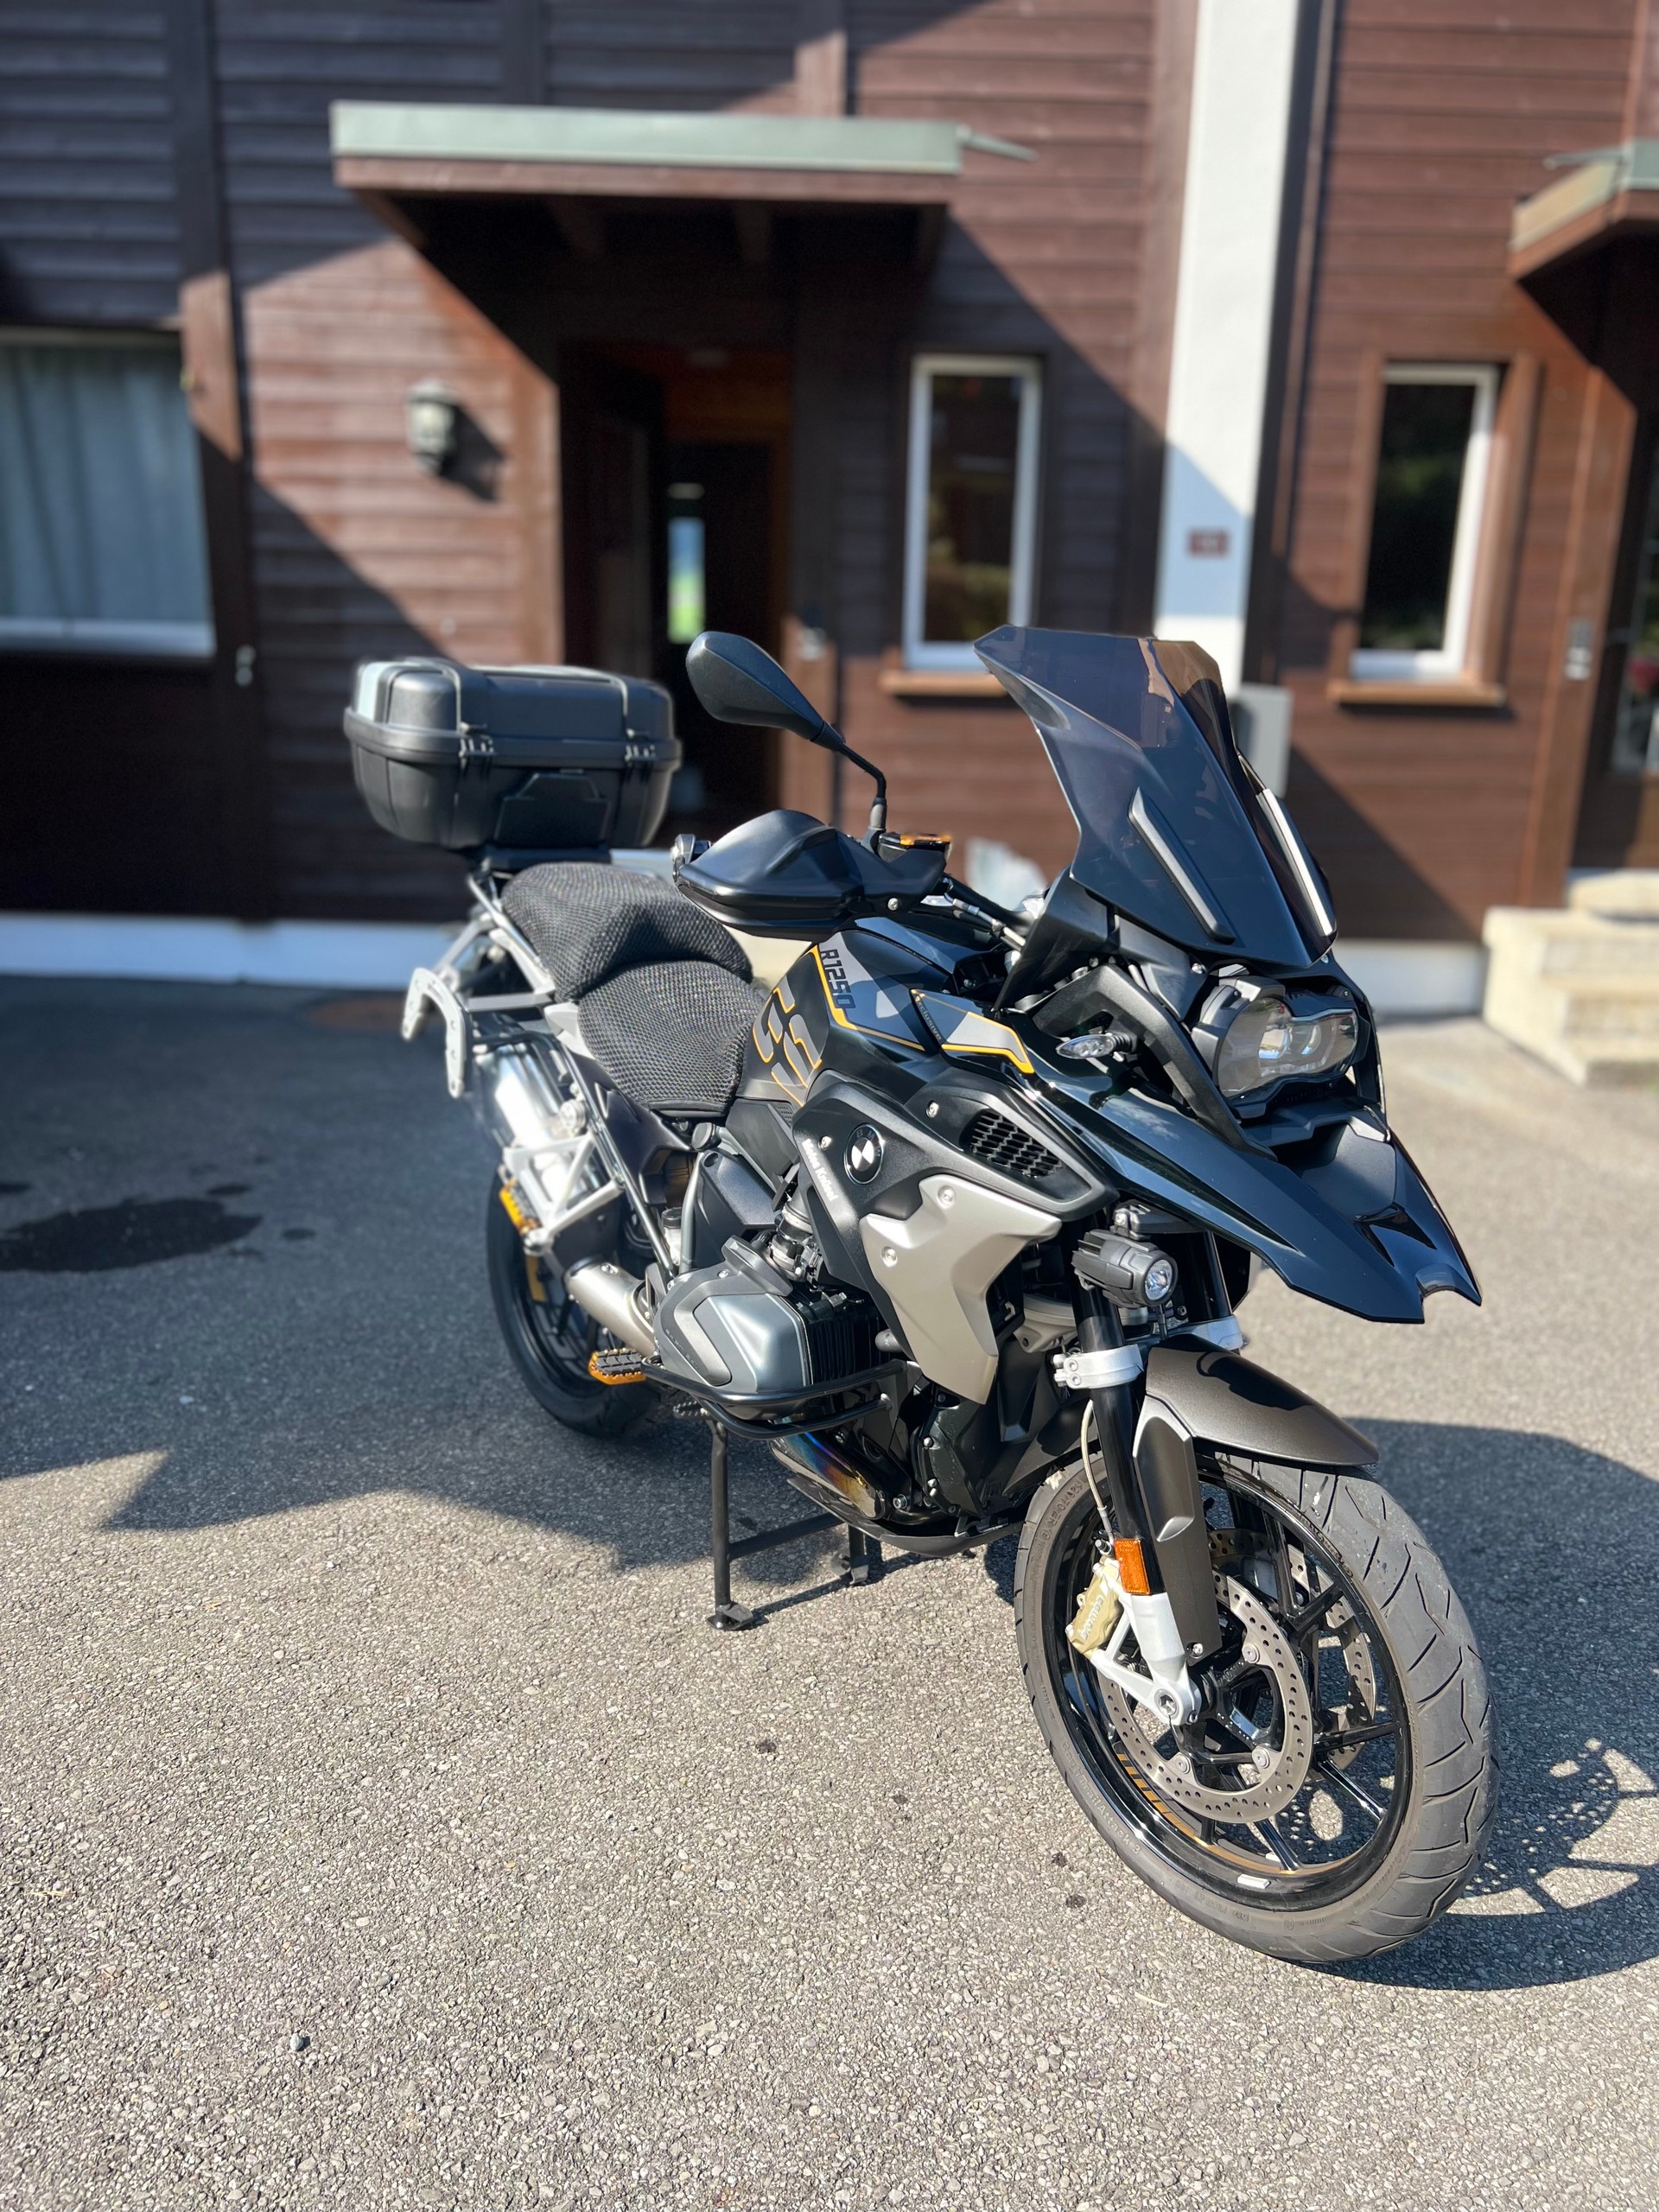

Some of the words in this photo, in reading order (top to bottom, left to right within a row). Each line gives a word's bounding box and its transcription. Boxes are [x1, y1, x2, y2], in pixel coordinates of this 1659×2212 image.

[821, 948, 856, 1009] R1250
[855, 1128, 881, 1157] BMW
[1079, 1594, 1104, 1641] brembo
[1132, 1844, 1141, 1855] 3
